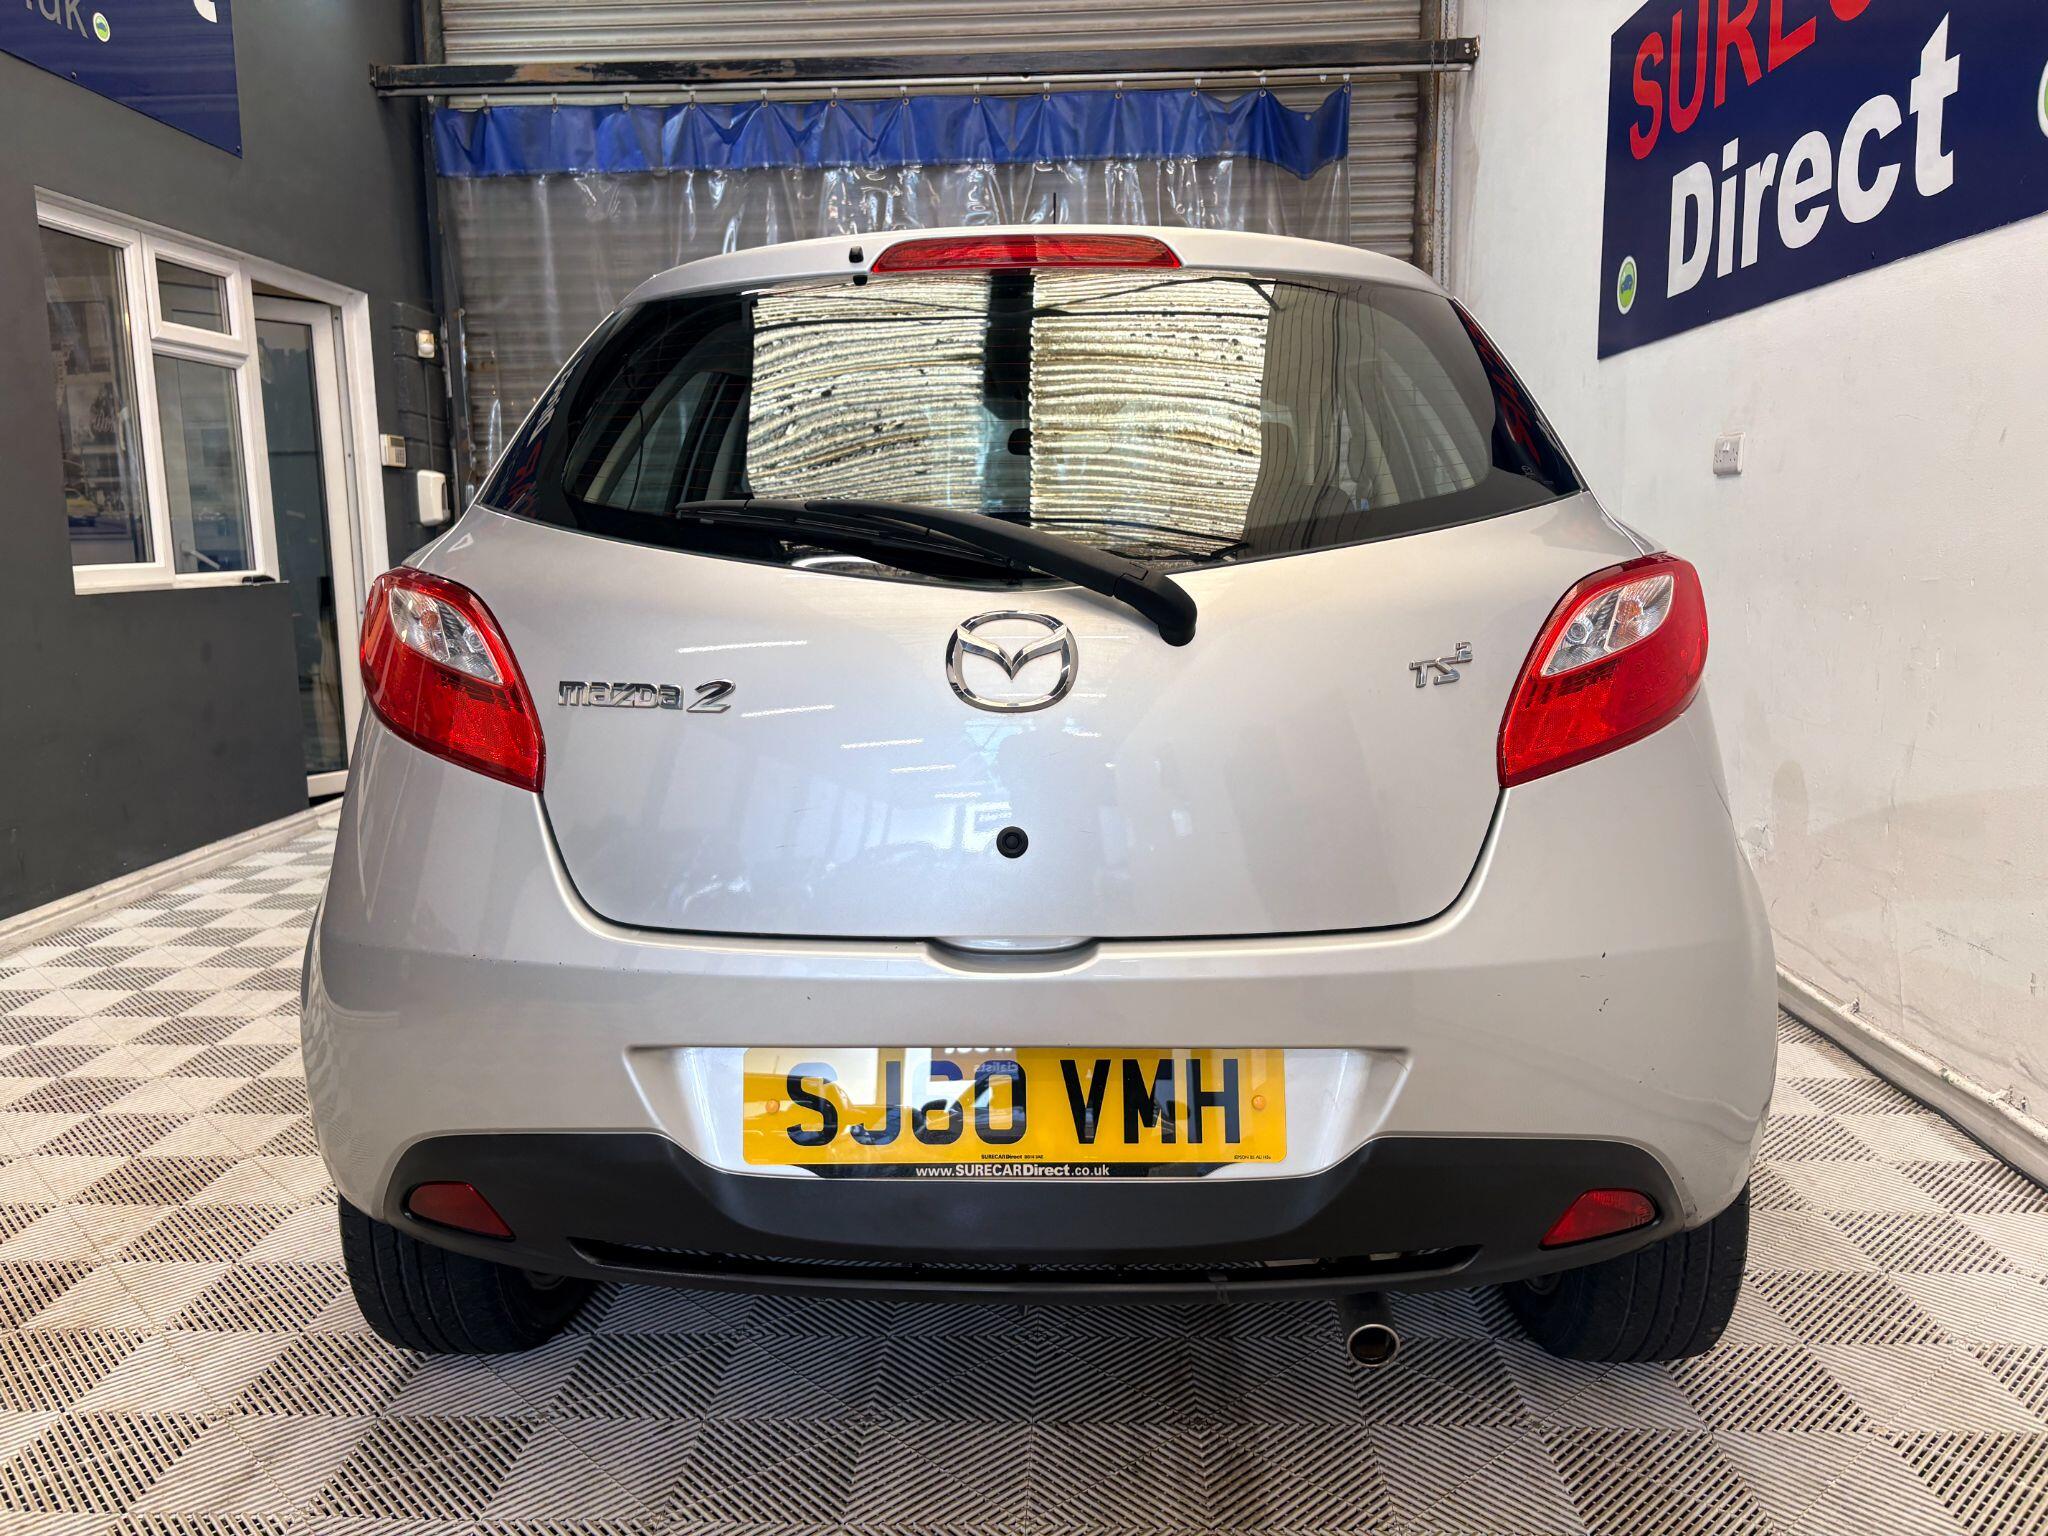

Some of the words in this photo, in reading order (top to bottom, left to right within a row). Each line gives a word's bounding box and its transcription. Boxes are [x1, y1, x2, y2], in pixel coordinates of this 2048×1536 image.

[1667, 12, 1960, 299] Direct
[686, 678, 737, 713] 2
[787, 1060, 1027, 1146] SJ60
[1060, 1059, 1240, 1144] VMH
[916, 1164, 1110, 1177] www.SURECARDirect.co.uk
